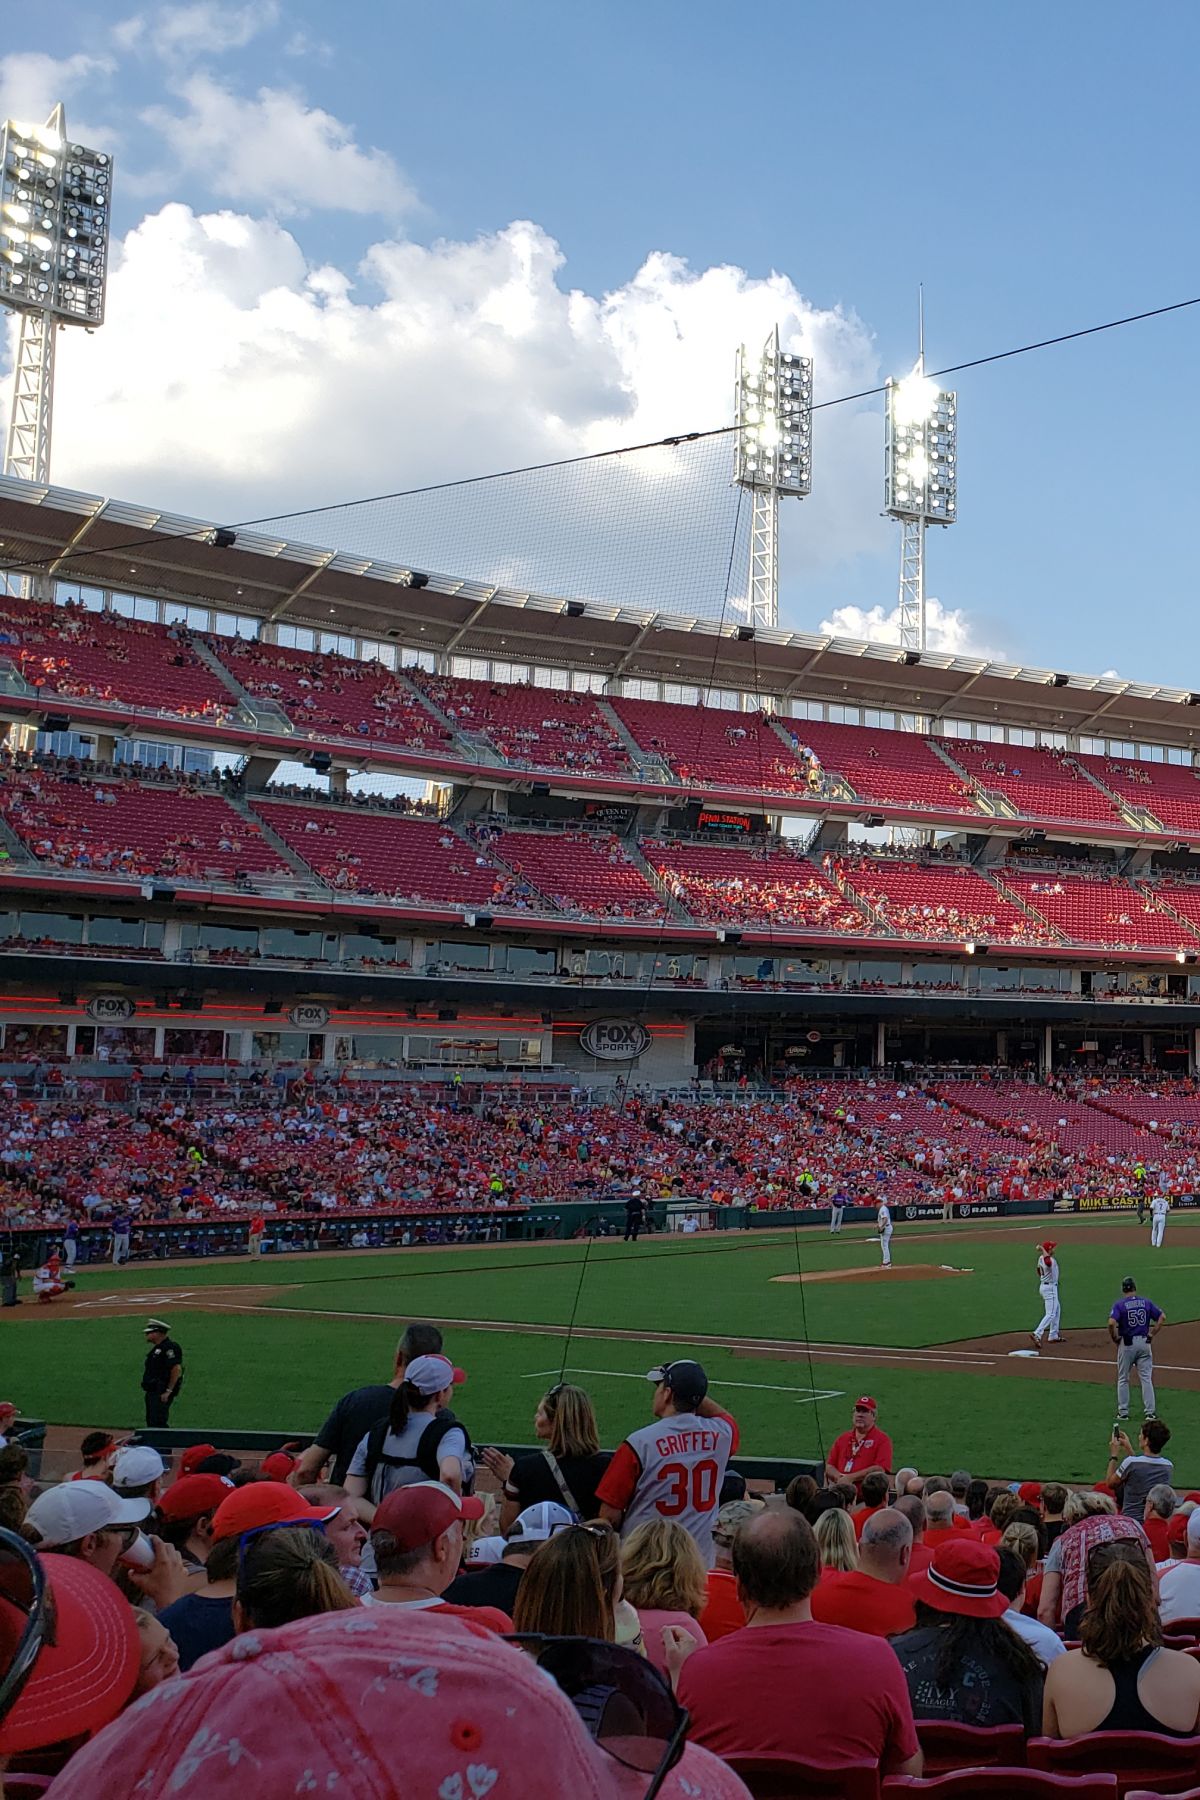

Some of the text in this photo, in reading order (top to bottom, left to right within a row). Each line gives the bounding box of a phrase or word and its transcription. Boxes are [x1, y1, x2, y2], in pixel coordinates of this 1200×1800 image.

[699, 812, 750, 831] PENN STATION
[97, 999, 125, 1011] FOX
[297, 1006, 321, 1019] FOX
[596, 1023, 637, 1044] FOX
[595, 1043, 637, 1051] SPORTS
[1079, 1197, 1109, 1208] MIKE
[1127, 1308, 1147, 1327] 53
[656, 1430, 720, 1457] GRIFFEY
[656, 1459, 719, 1516] 30
[927, 1685, 959, 1700] IVY
[925, 1698, 958, 1707] LEAGUE
